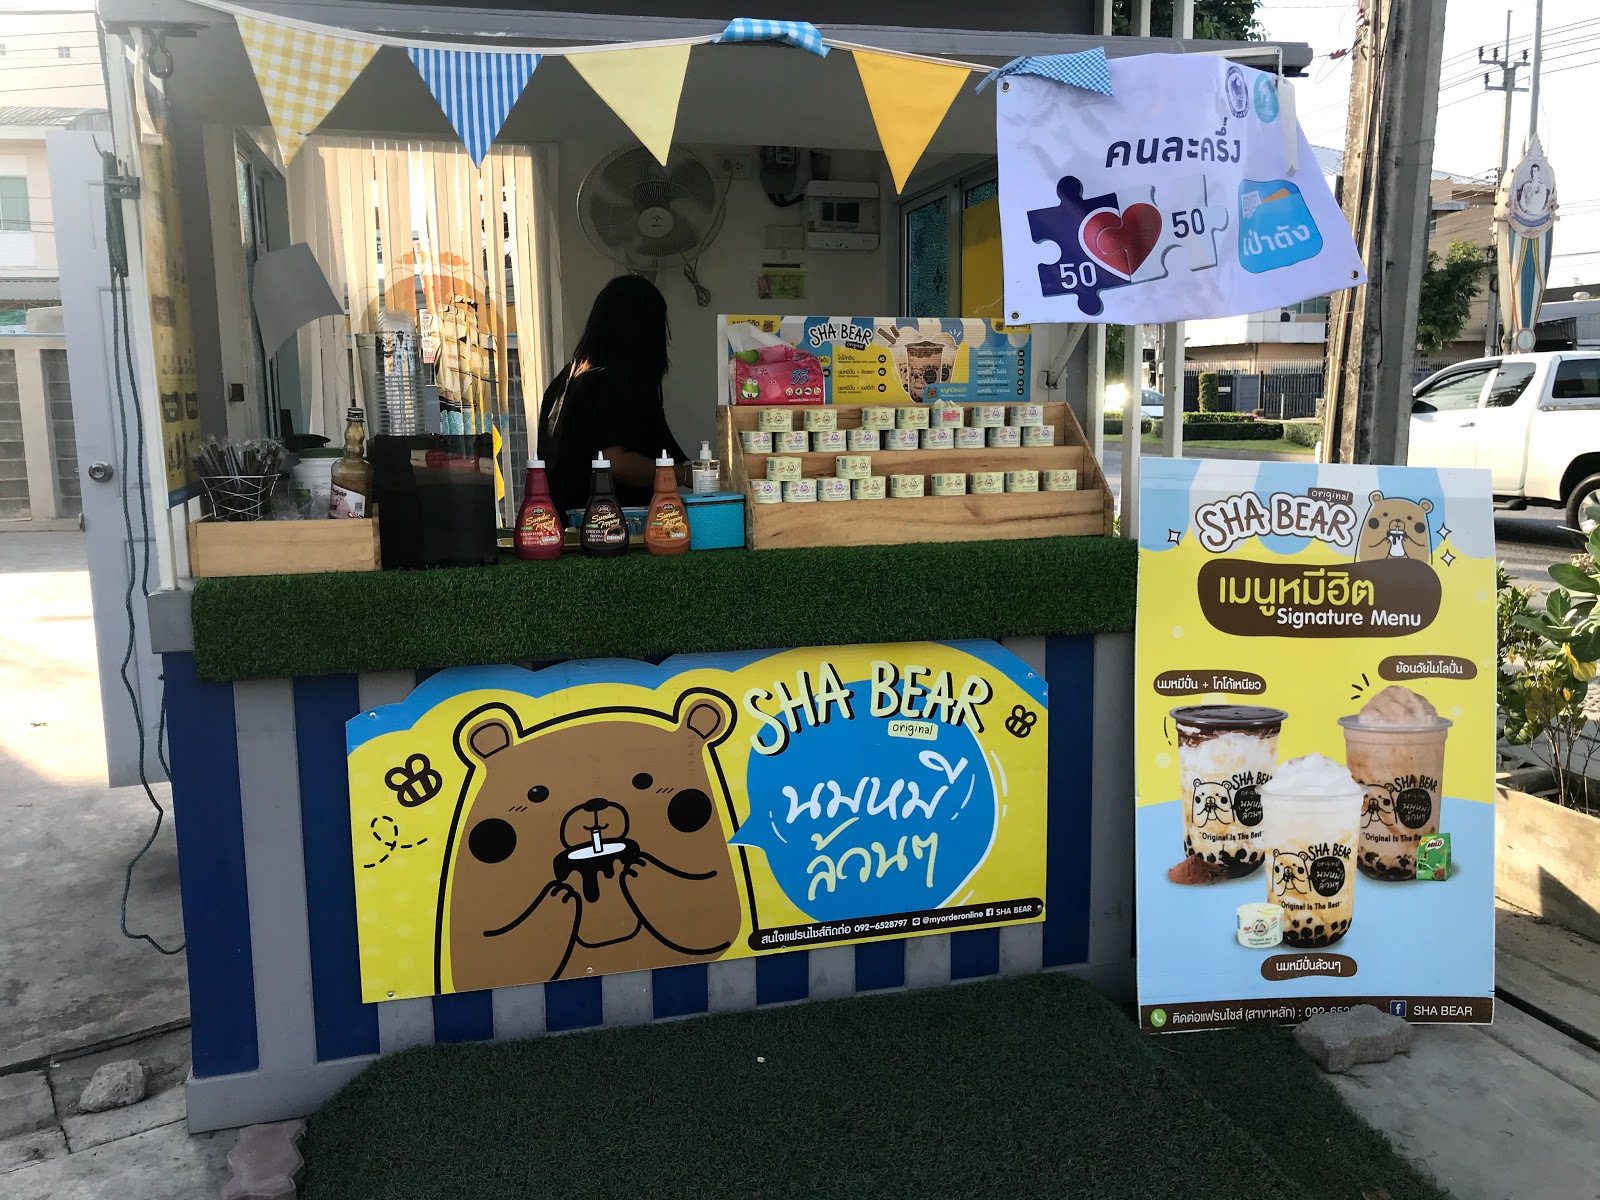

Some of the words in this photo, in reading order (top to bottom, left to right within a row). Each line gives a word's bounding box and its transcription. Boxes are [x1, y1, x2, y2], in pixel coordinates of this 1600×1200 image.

[1105, 117, 1241, 168] คนละครึ่ง
[1172, 208, 1205, 239] 50
[1059, 262, 1097, 290] 50
[810, 323, 836, 346] SHA
[841, 324, 872, 345] BEAR
[1311, 489, 1350, 502] original
[1202, 498, 1264, 547] SHA
[1276, 498, 1349, 541] BEAR
[1219, 567, 1375, 617] เมนูหมีฮิต
[1277, 608, 1364, 629] Signature
[1370, 609, 1421, 627] Menu
[1396, 659, 1463, 674] ย้อนวัยไมโลปั่น
[1157, 675, 1199, 690] นมหมีปั่น
[1212, 676, 1262, 690] โกโก้เหนียว
[742, 661, 854, 756] SHA
[870, 660, 993, 733] BEAR
[892, 722, 934, 737] original
[782, 750, 969, 824] นมหมี
[1232, 771, 1254, 791] SHA
[1394, 774, 1417, 793] SHA
[1419, 774, 1438, 793] BEAR
[1238, 832, 1249, 840] The
[1400, 834, 1412, 842] The
[806, 816, 939, 901] ล้วนๆ
[1308, 843, 1330, 861] SHA
[1332, 843, 1352, 860] BEAR
[1314, 902, 1326, 910] The
[761, 924, 852, 944] สนใจแฟรนไชส์ติดต่อ
[922, 910, 984, 925] @myorderonline
[996, 908, 1012, 917] SHA
[1014, 905, 1032, 914] BEAR
[1276, 956, 1341, 973] นมหมีปั่นล้วนๆ
[1172, 1008, 1243, 1024] ติดต่อแฟรนไชส์
[1245, 1006, 1296, 1021] (สาขาหลัก)
[1413, 1006, 1438, 1017] SHA
[1441, 1006, 1473, 1017] BEAR
